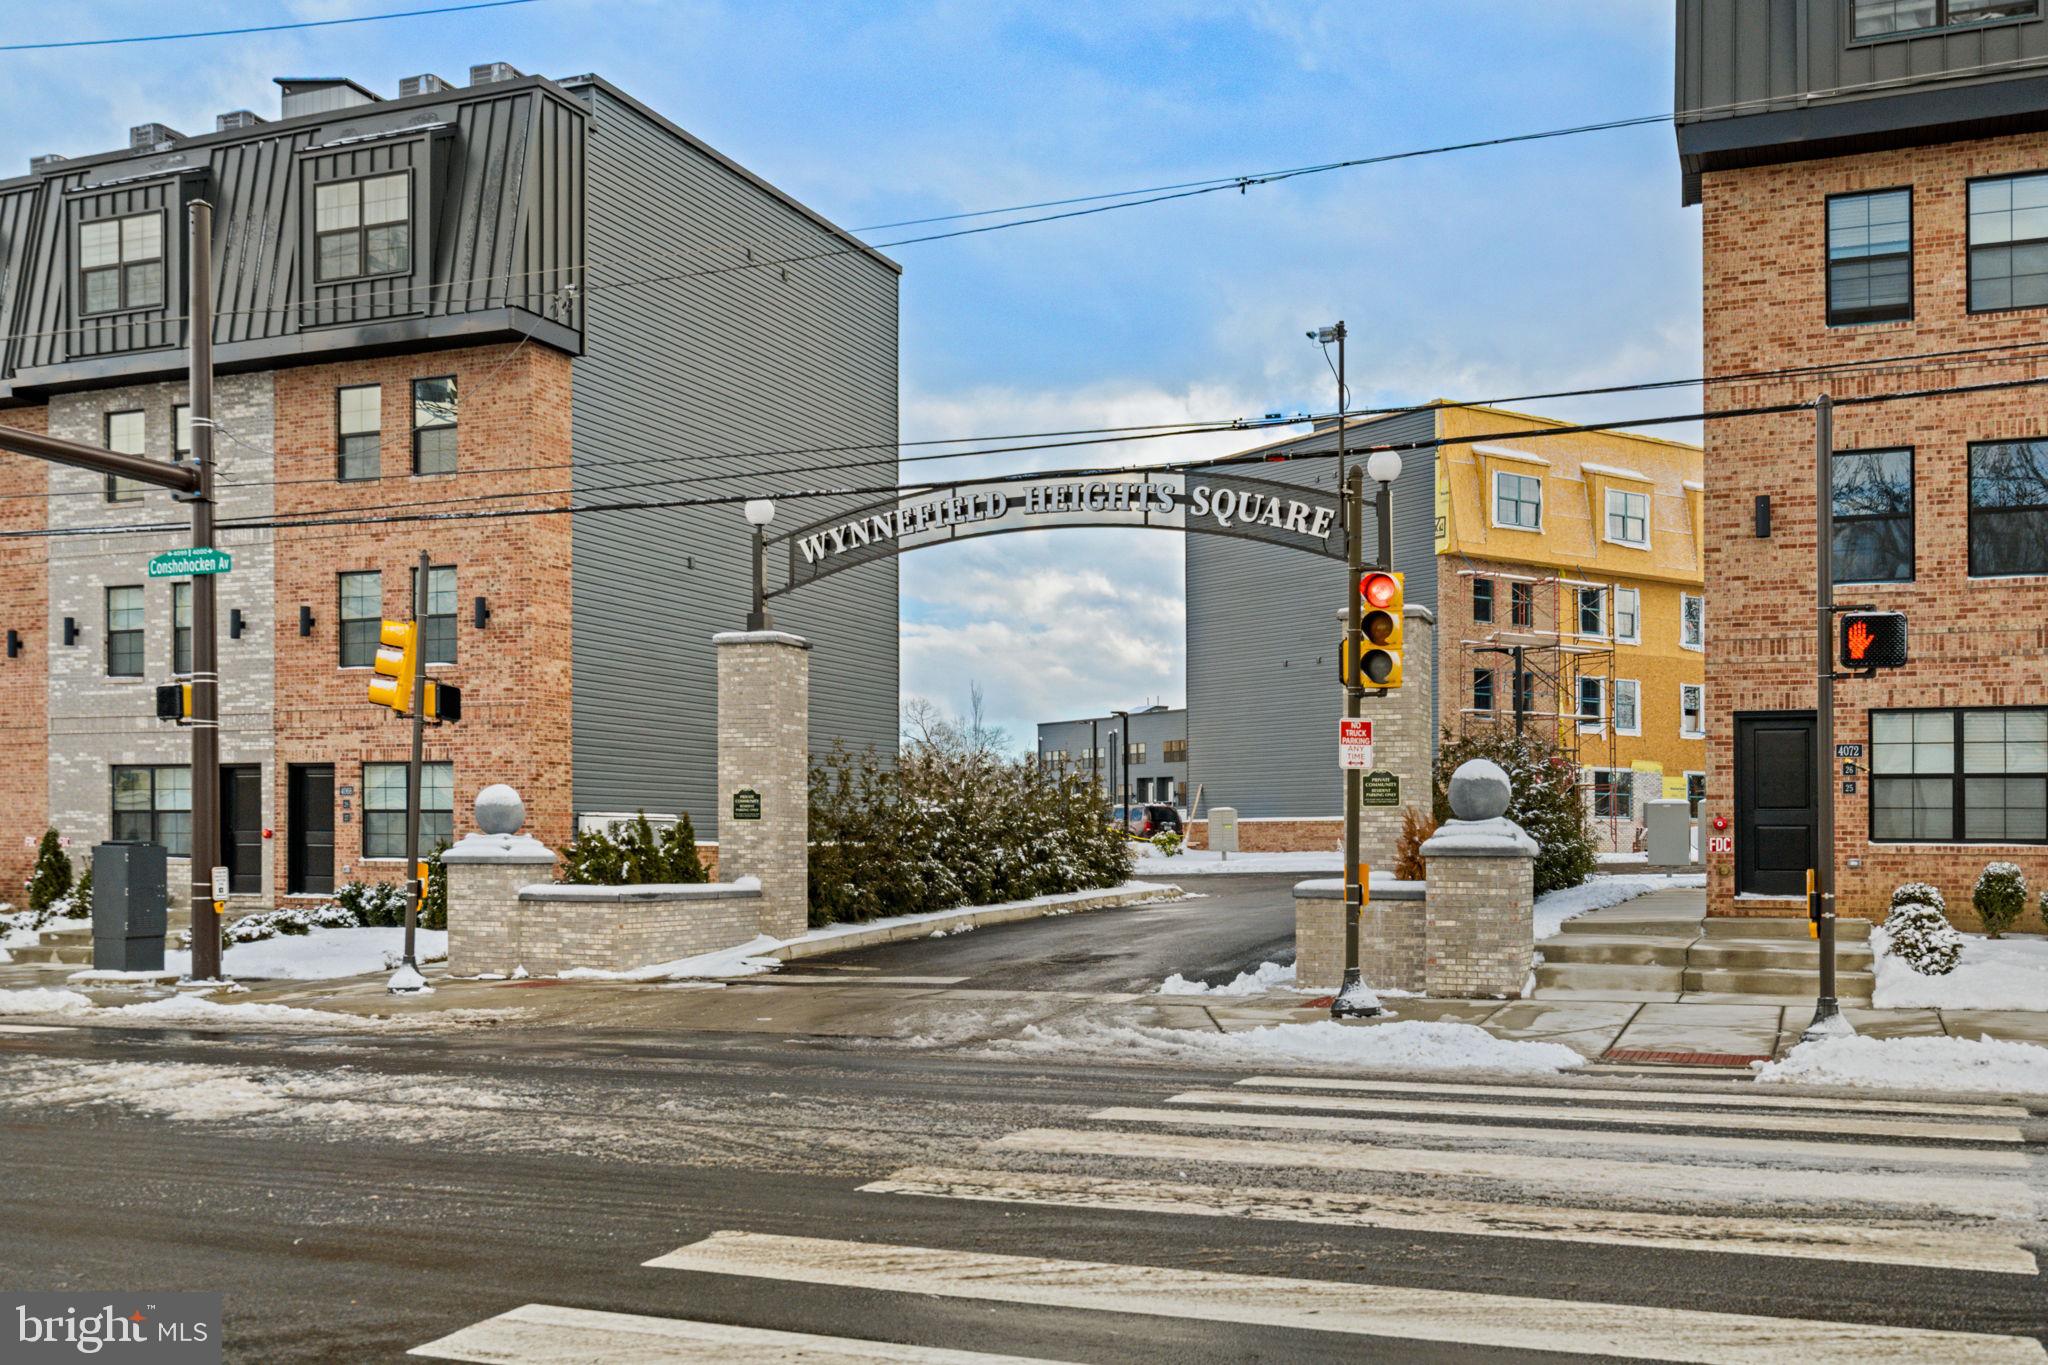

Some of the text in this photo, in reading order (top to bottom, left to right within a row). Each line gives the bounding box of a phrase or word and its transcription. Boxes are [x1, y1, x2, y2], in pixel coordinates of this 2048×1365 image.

[796, 481, 1336, 565] WYNNEFIELD HEIGHTS SQUARE
[150, 557, 230, 575] Conshohocken Av
[1345, 729, 1367, 737] TRUCK
[1342, 737, 1371, 745] PARKING
[1838, 745, 1860, 757] 4072
[1845, 765, 1854, 774] 26
[1845, 784, 1854, 793] 25
[1709, 837, 1732, 852] FDC
